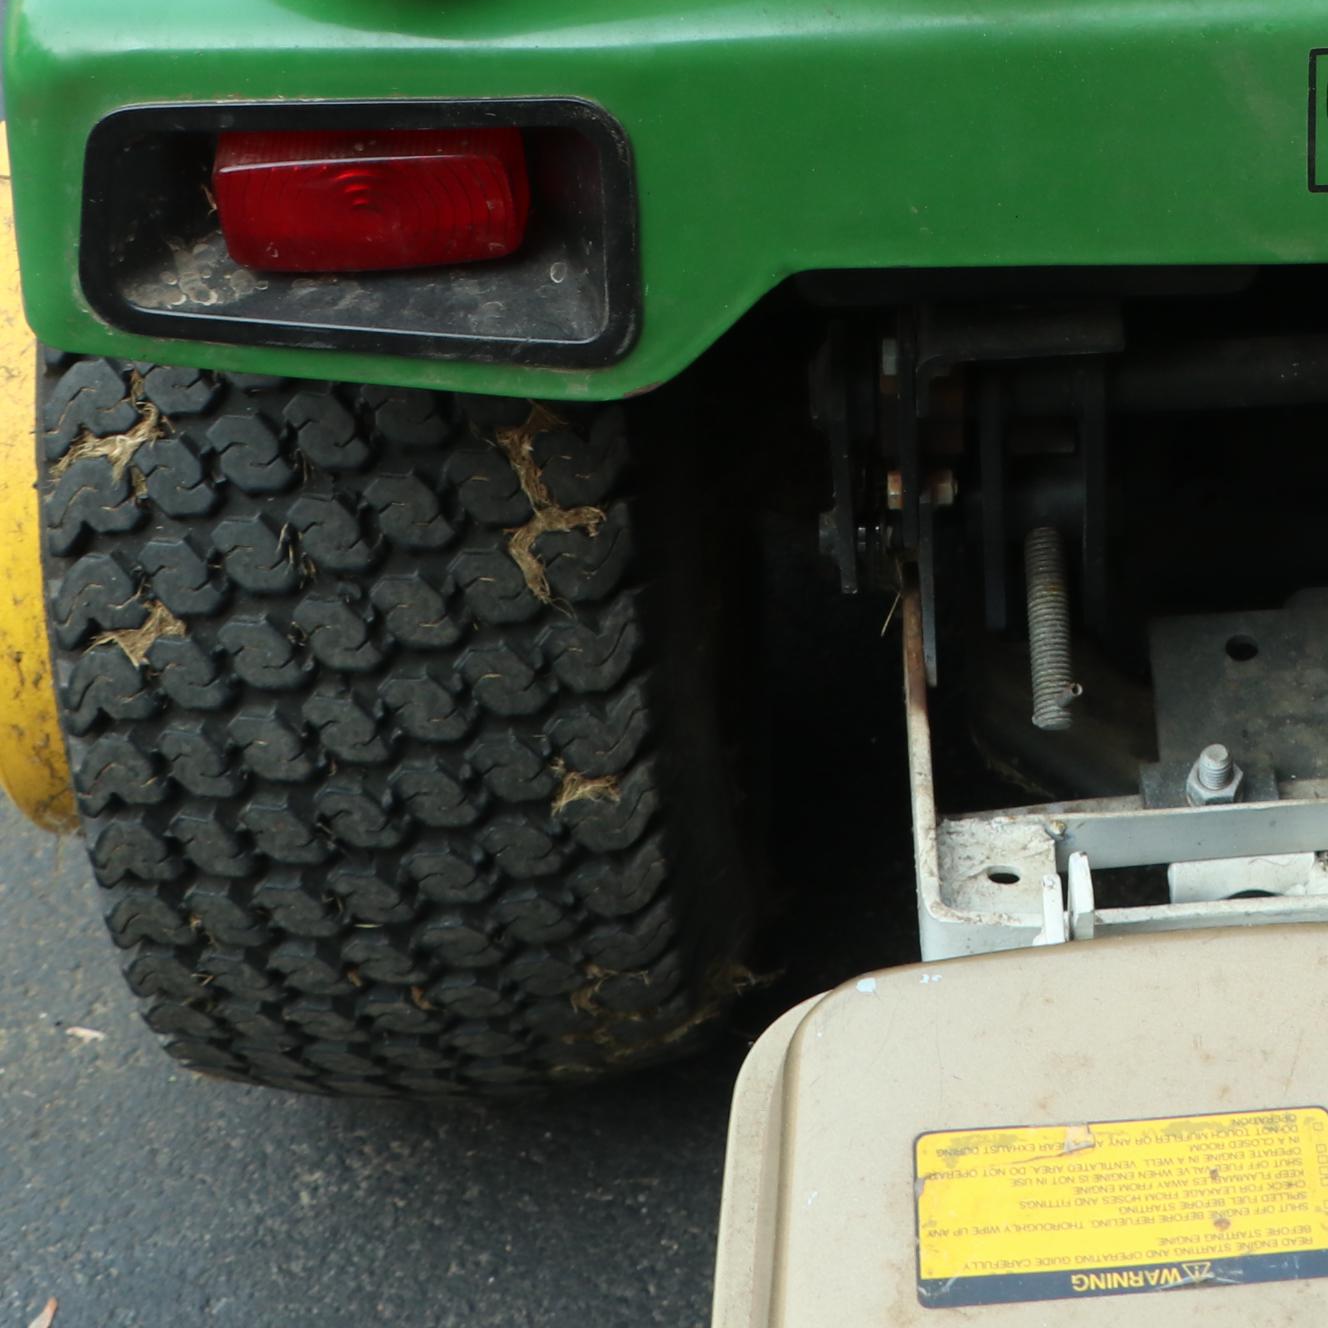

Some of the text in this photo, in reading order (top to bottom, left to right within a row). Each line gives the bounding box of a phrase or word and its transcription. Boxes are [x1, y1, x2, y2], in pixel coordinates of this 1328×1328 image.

[1227, 1138, 1274, 1148] CLOSED
[982, 1143, 1035, 1154] EXHAUST
[1249, 1147, 1301, 1158] OPERATE
[1201, 1151, 1245, 1161] ENGINE
[1246, 1160, 1269, 1169] OFF
[1272, 1158, 1303, 1167] SHUT
[981, 1168, 1005, 1177] NOT
[1137, 1168, 1170, 1177] WHEN
[1175, 1165, 1210, 1174] VALVE
[1274, 1170, 1304, 1178] KEEP
[1050, 1175, 1075, 1183] NOT
[1090, 1170, 1134, 1180] ENGINE
[1118, 1182, 1152, 1190] FROM
[1156, 1179, 1187, 1187] AWAY
[1267, 1181, 1306, 1190] CHECK
[1182, 1186, 1236, 1197] LEAKAGE
[1239, 1184, 1263, 1193] FOR
[1102, 1193, 1140, 1203] HOSES
[1144, 1190, 1178, 1200] FROM
[1229, 1195, 1257, 1204] FUEL
[1073, 1196, 1097, 1205] AND
[1179, 1197, 1225, 1208] BEFORE
[1278, 1203, 1309, 1212] SHUT
[1158, 1210, 1203, 1221] BEFORE
[968, 1225, 999, 1235] WIPE
[1004, 1219, 1083, 1232] THOROUGHLY
[1203, 1230, 1262, 1241] STARTING
[1264, 1226, 1312, 1236] BEFORE
[961, 1237, 1313, 1271] READ ENGINE STARTING AND OPERATING GUIDE CAREFULLY
[1071, 1268, 1182, 1291] WARNING
